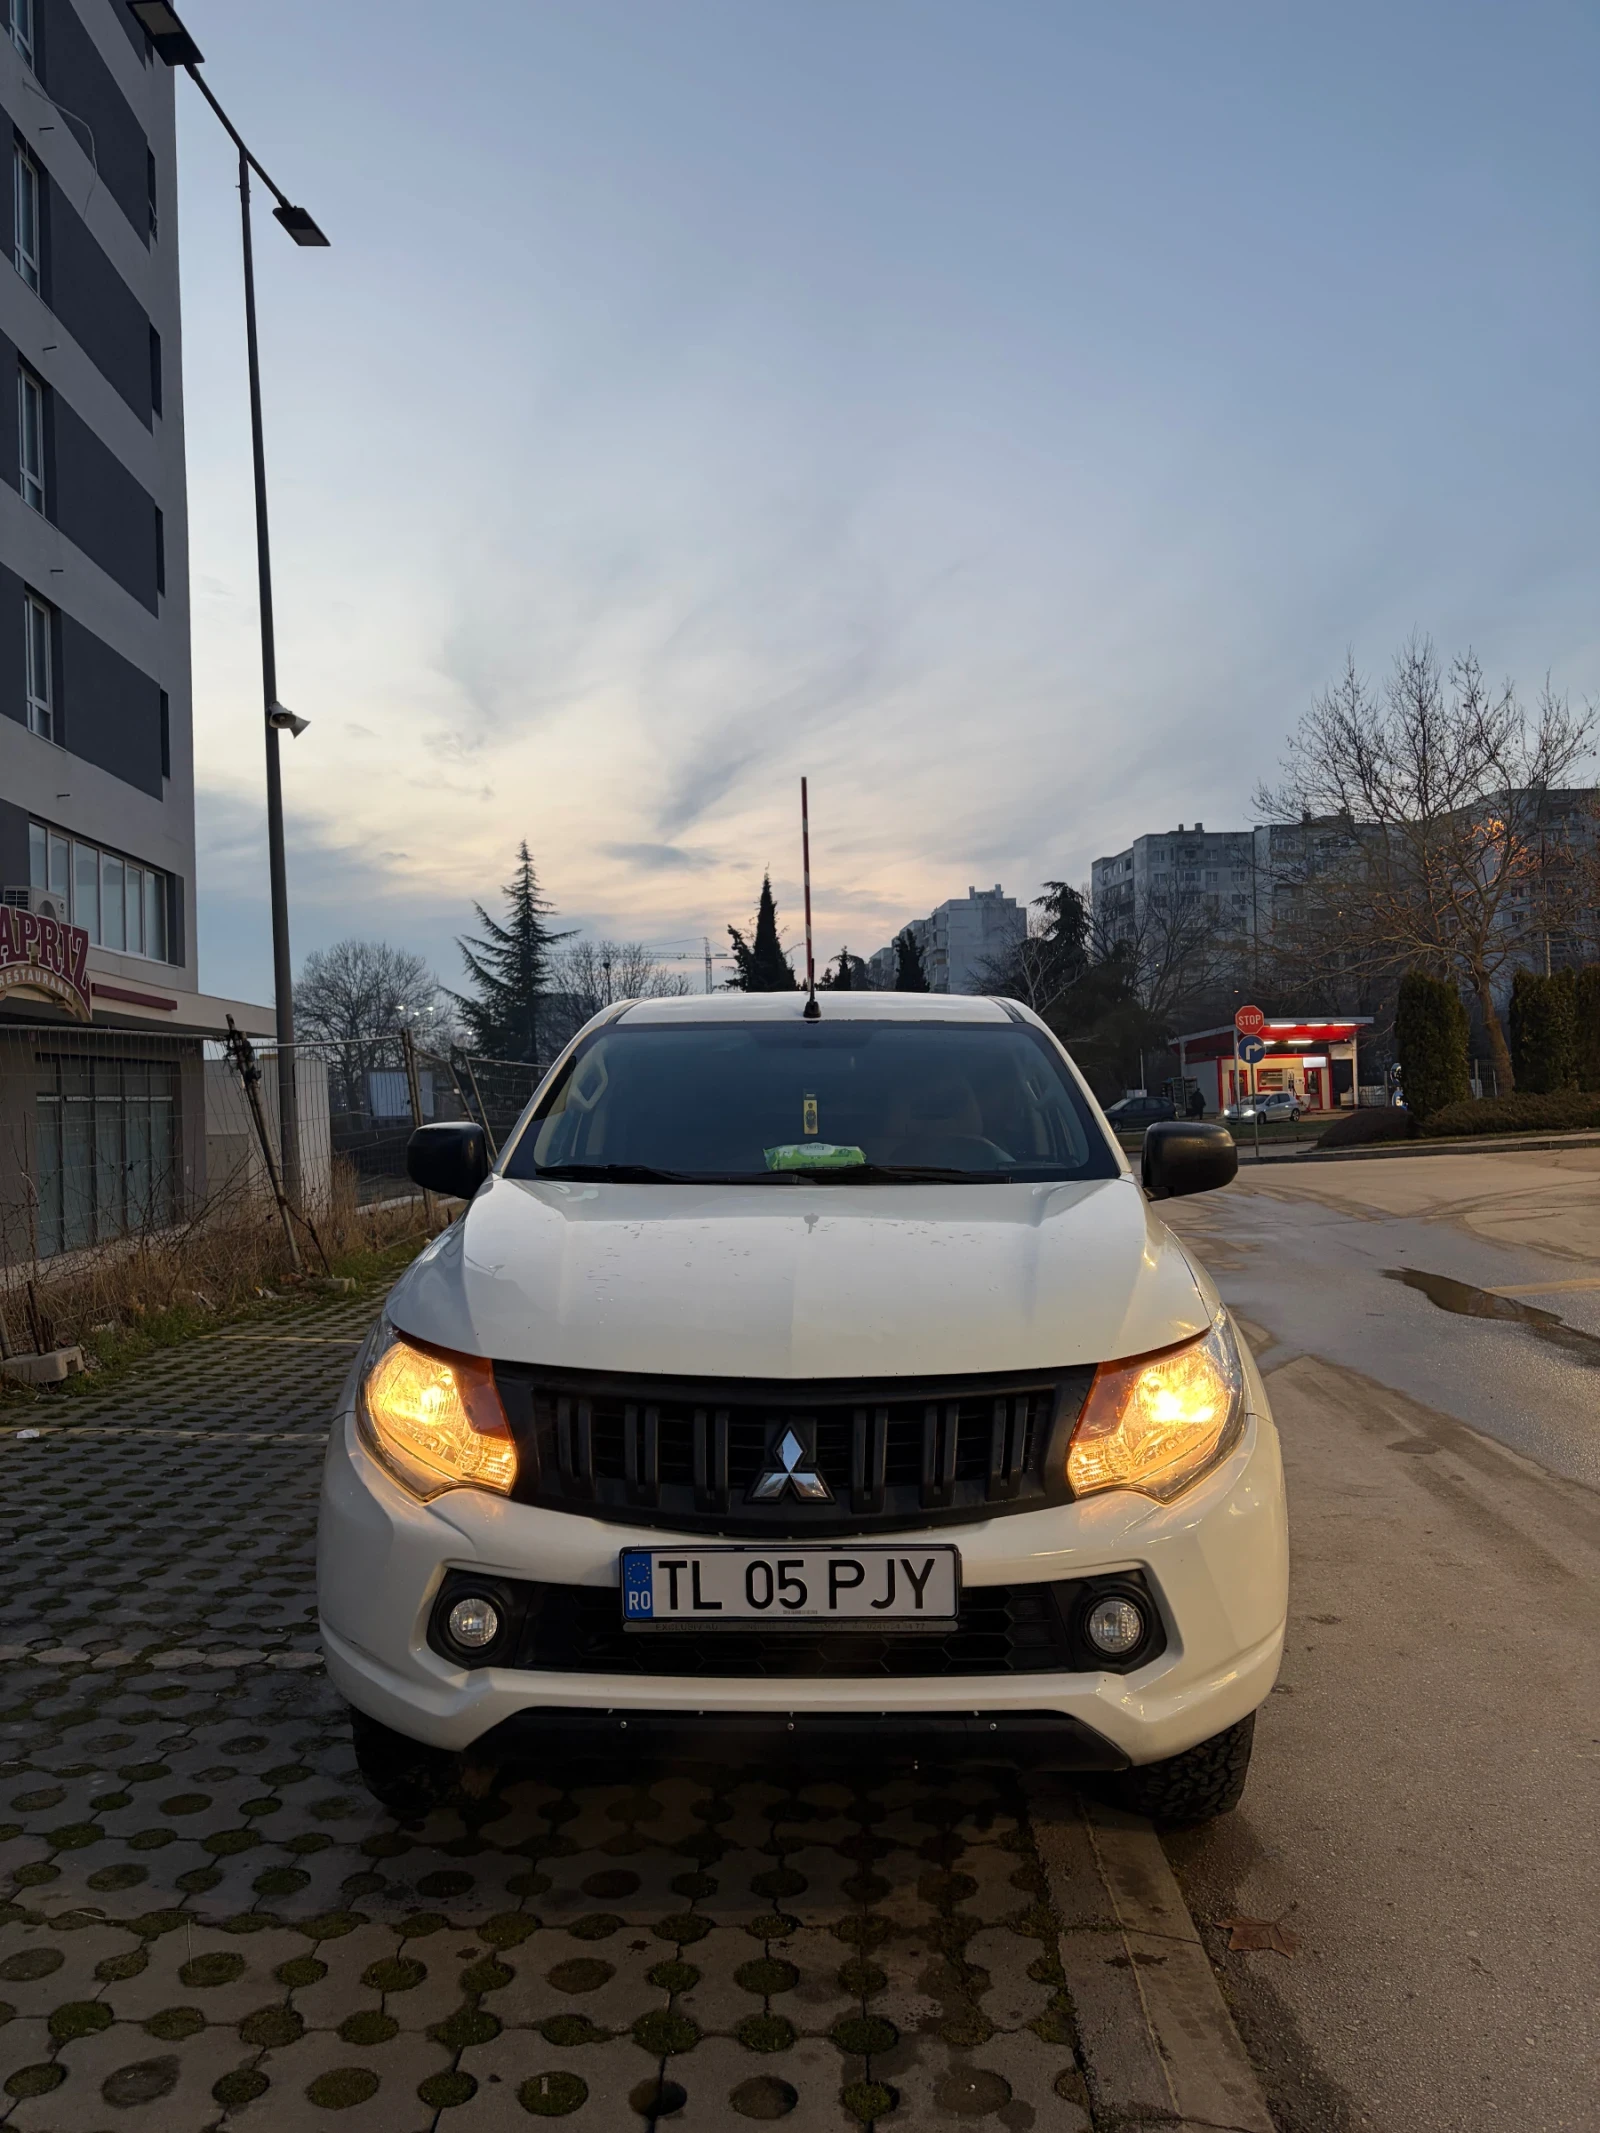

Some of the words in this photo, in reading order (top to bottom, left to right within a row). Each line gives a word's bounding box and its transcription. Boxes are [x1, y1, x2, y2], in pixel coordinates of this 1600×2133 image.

[0, 969, 70, 997] RESTAURANT
[1238, 1014, 1261, 1026] STOP
[658, 1560, 722, 1610] TL
[745, 1560, 808, 1610] 05
[828, 1558, 935, 1610] PJY
[628, 1590, 651, 1610] RO
